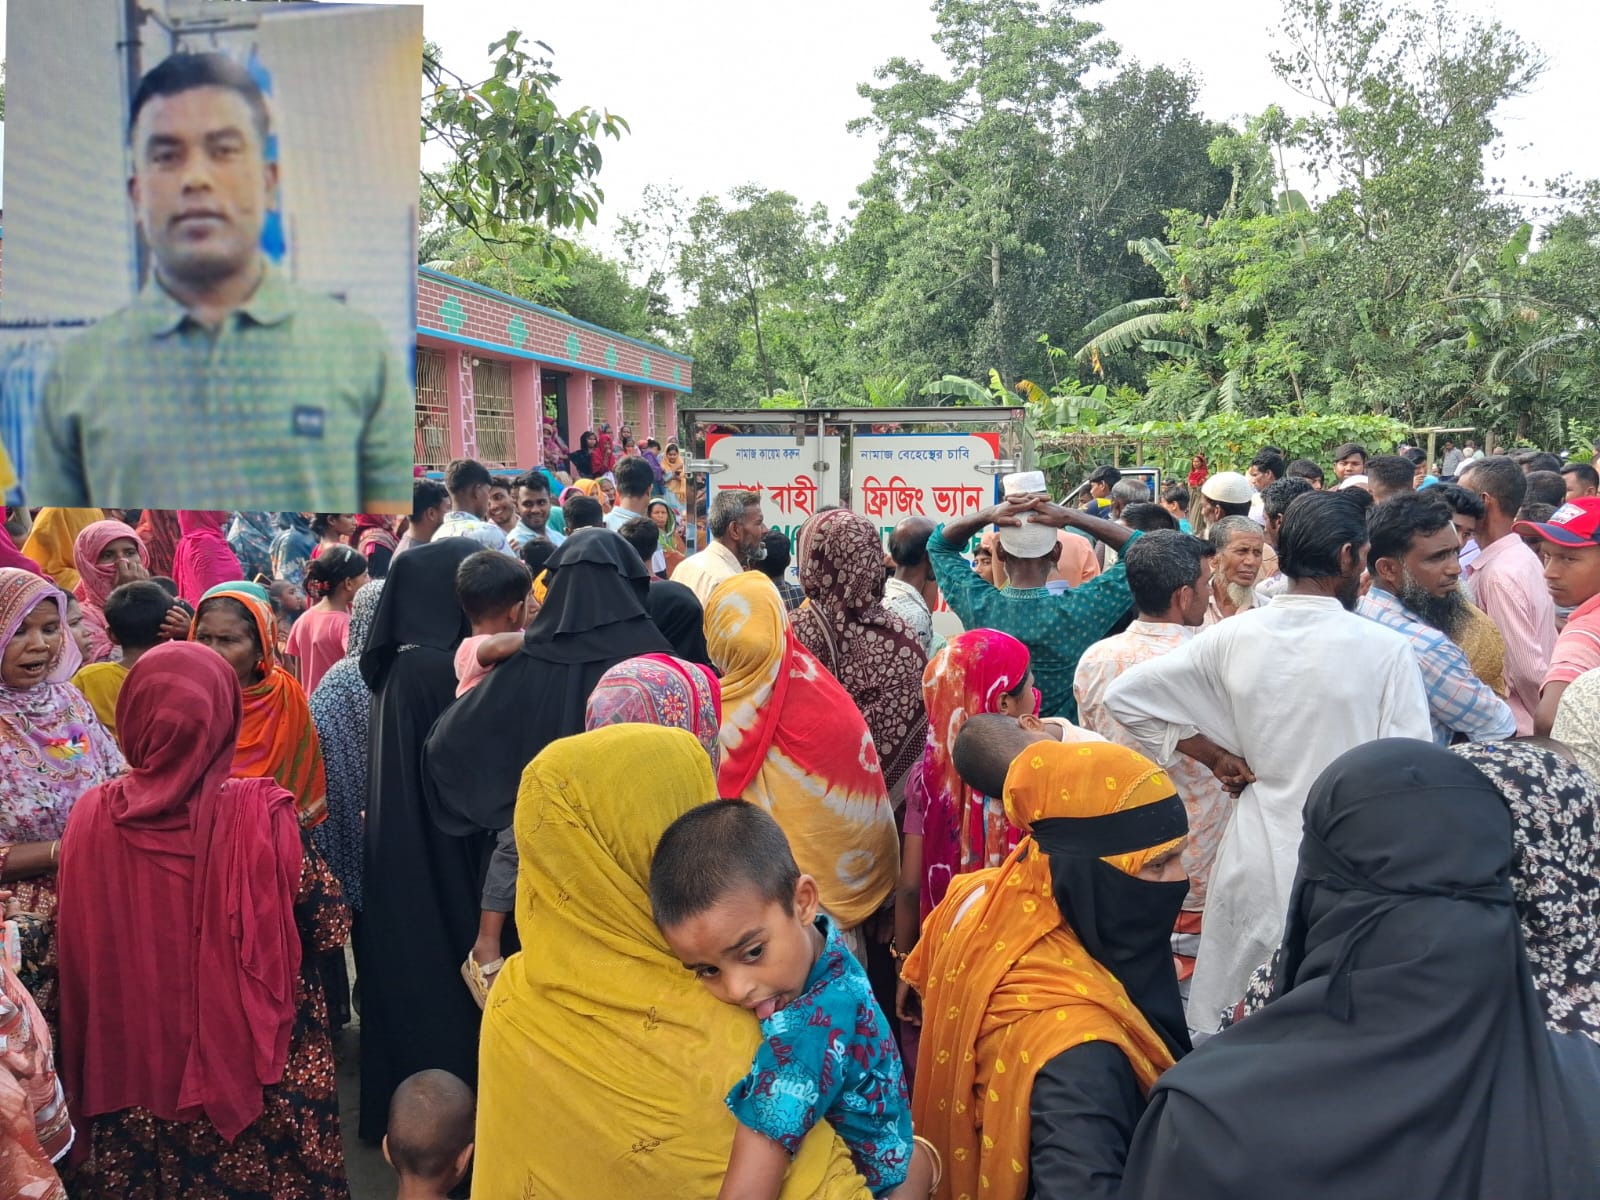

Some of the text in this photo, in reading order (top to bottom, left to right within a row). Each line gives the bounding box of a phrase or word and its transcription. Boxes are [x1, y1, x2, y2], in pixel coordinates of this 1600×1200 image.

[859, 450, 893, 461] নামাজ
[946, 445, 970, 461] চাবি
[767, 474, 818, 518] বাহী
[860, 475, 985, 520] ফ্রিজিং ভ্যান
